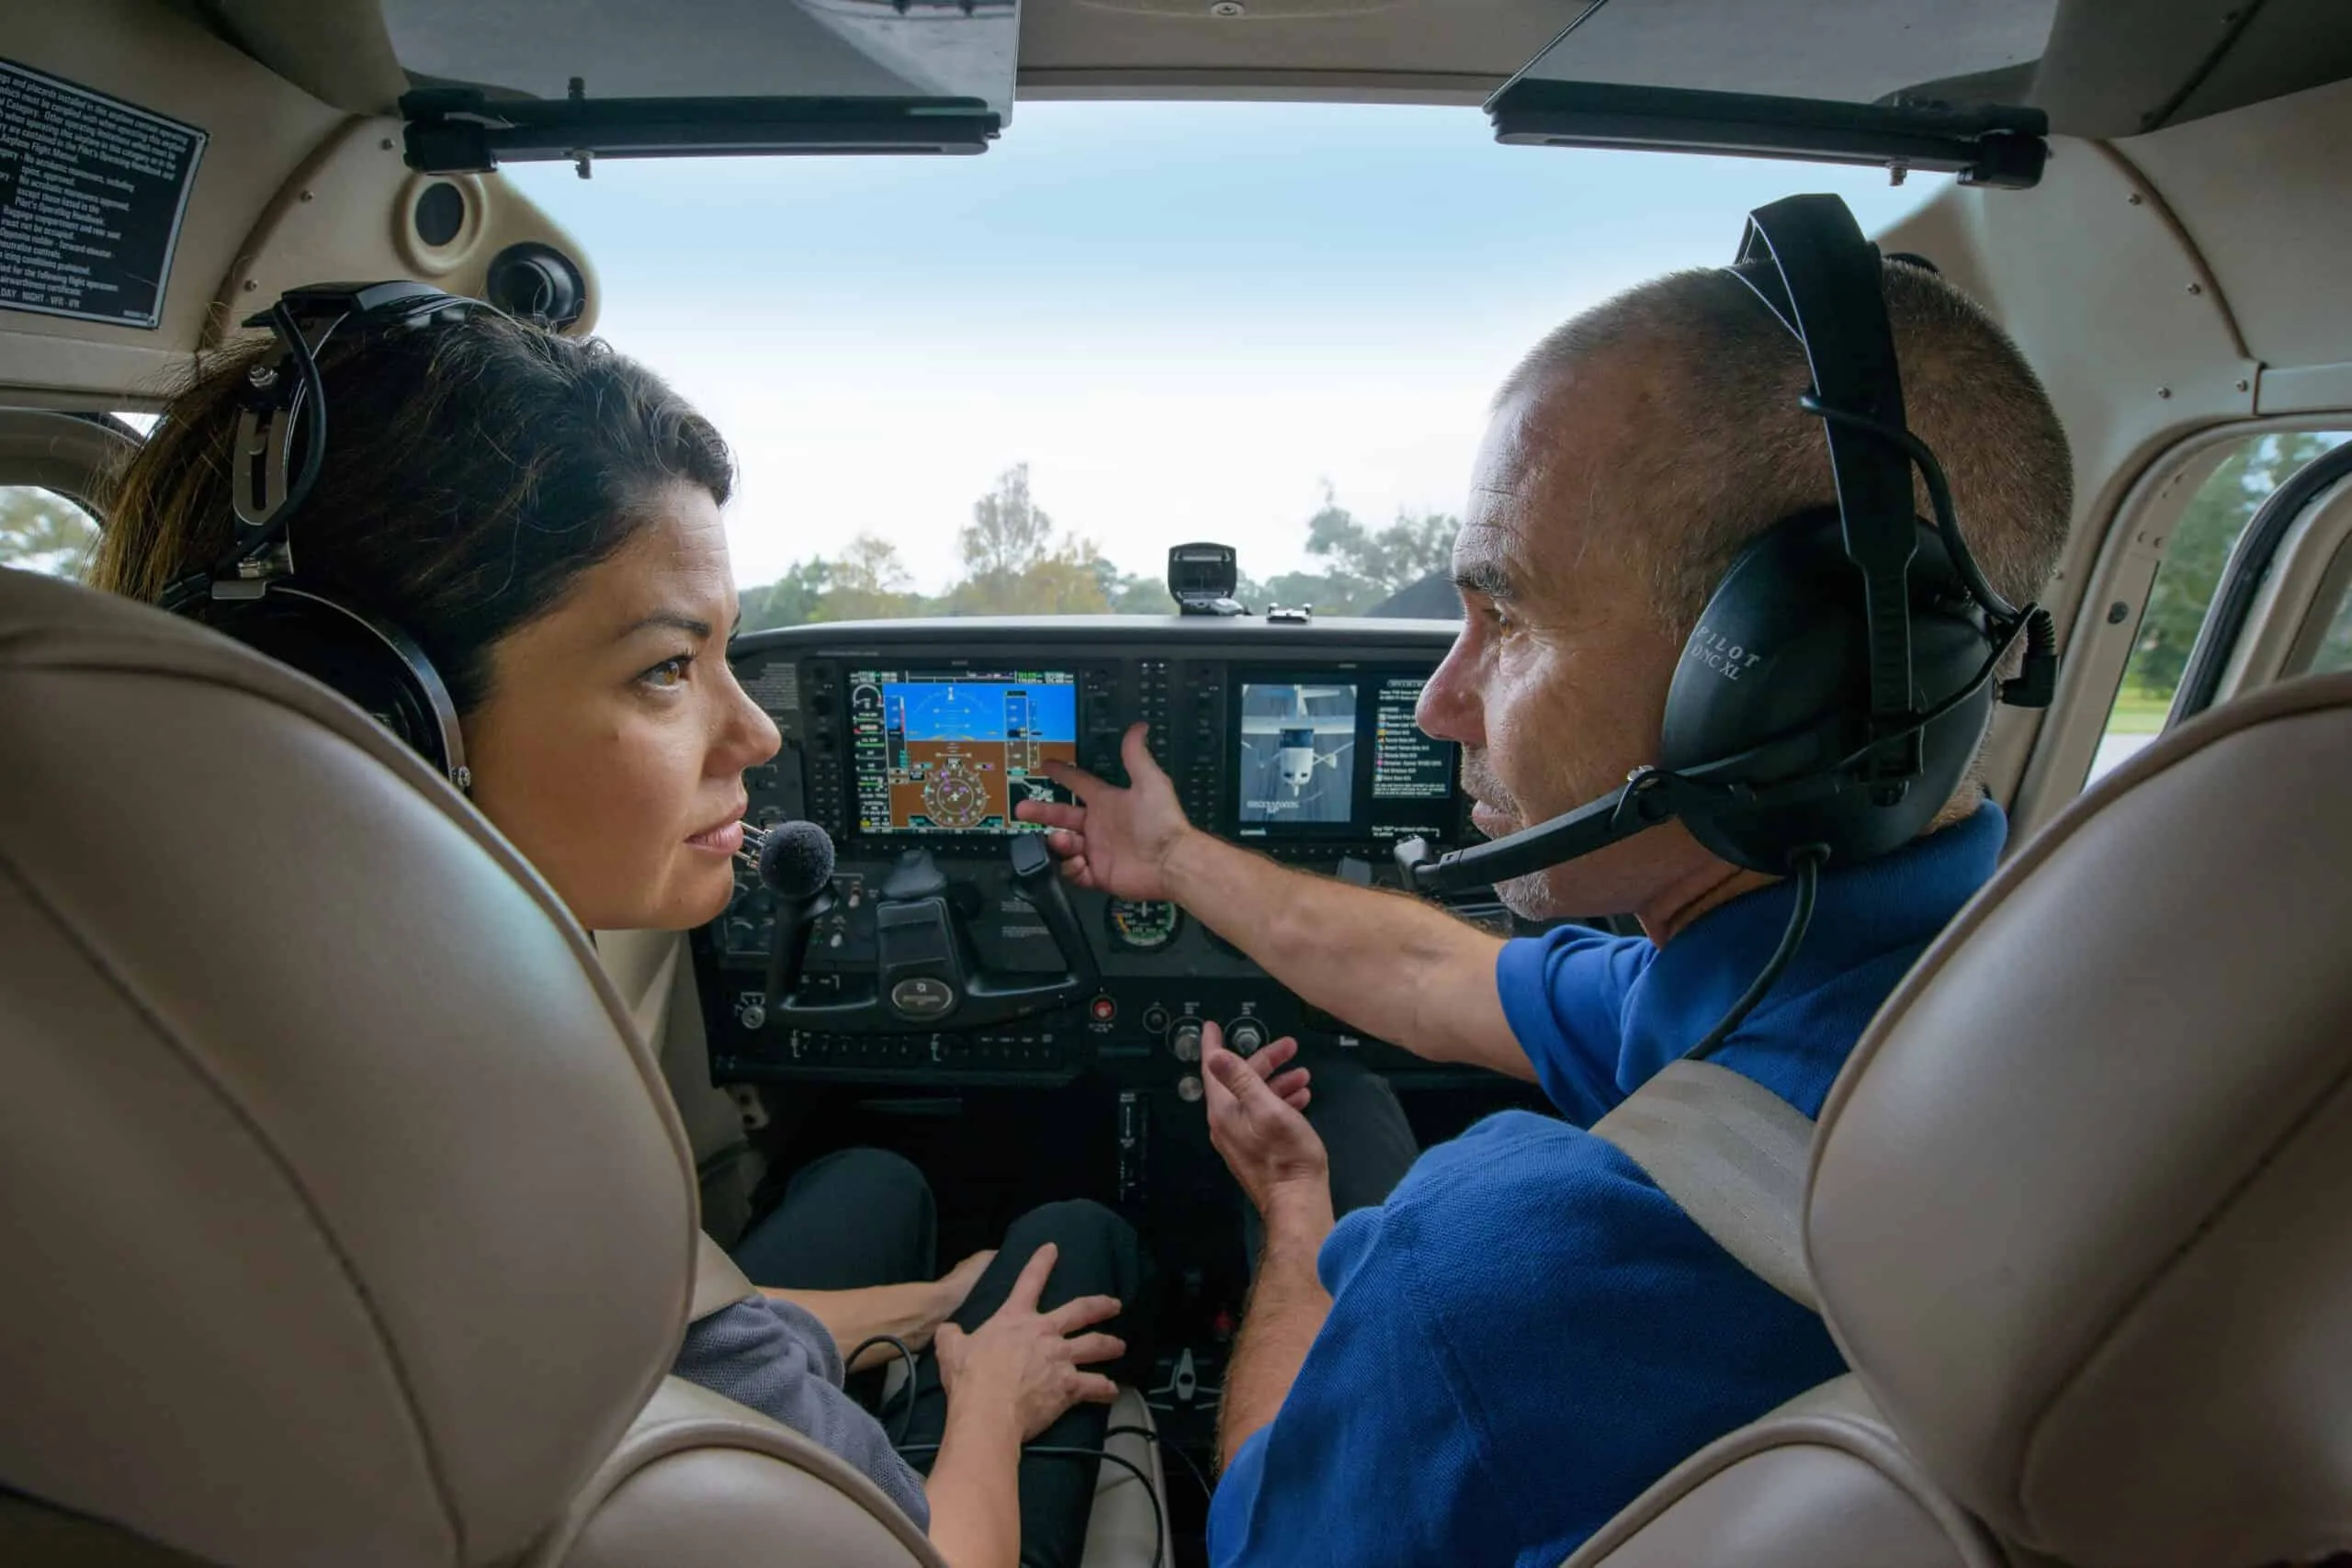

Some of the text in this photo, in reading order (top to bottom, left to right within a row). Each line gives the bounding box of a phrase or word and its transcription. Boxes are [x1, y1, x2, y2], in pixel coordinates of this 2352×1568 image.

[1690, 645, 1742, 681] DNC XL
[1696, 626, 1761, 668] PILOT
